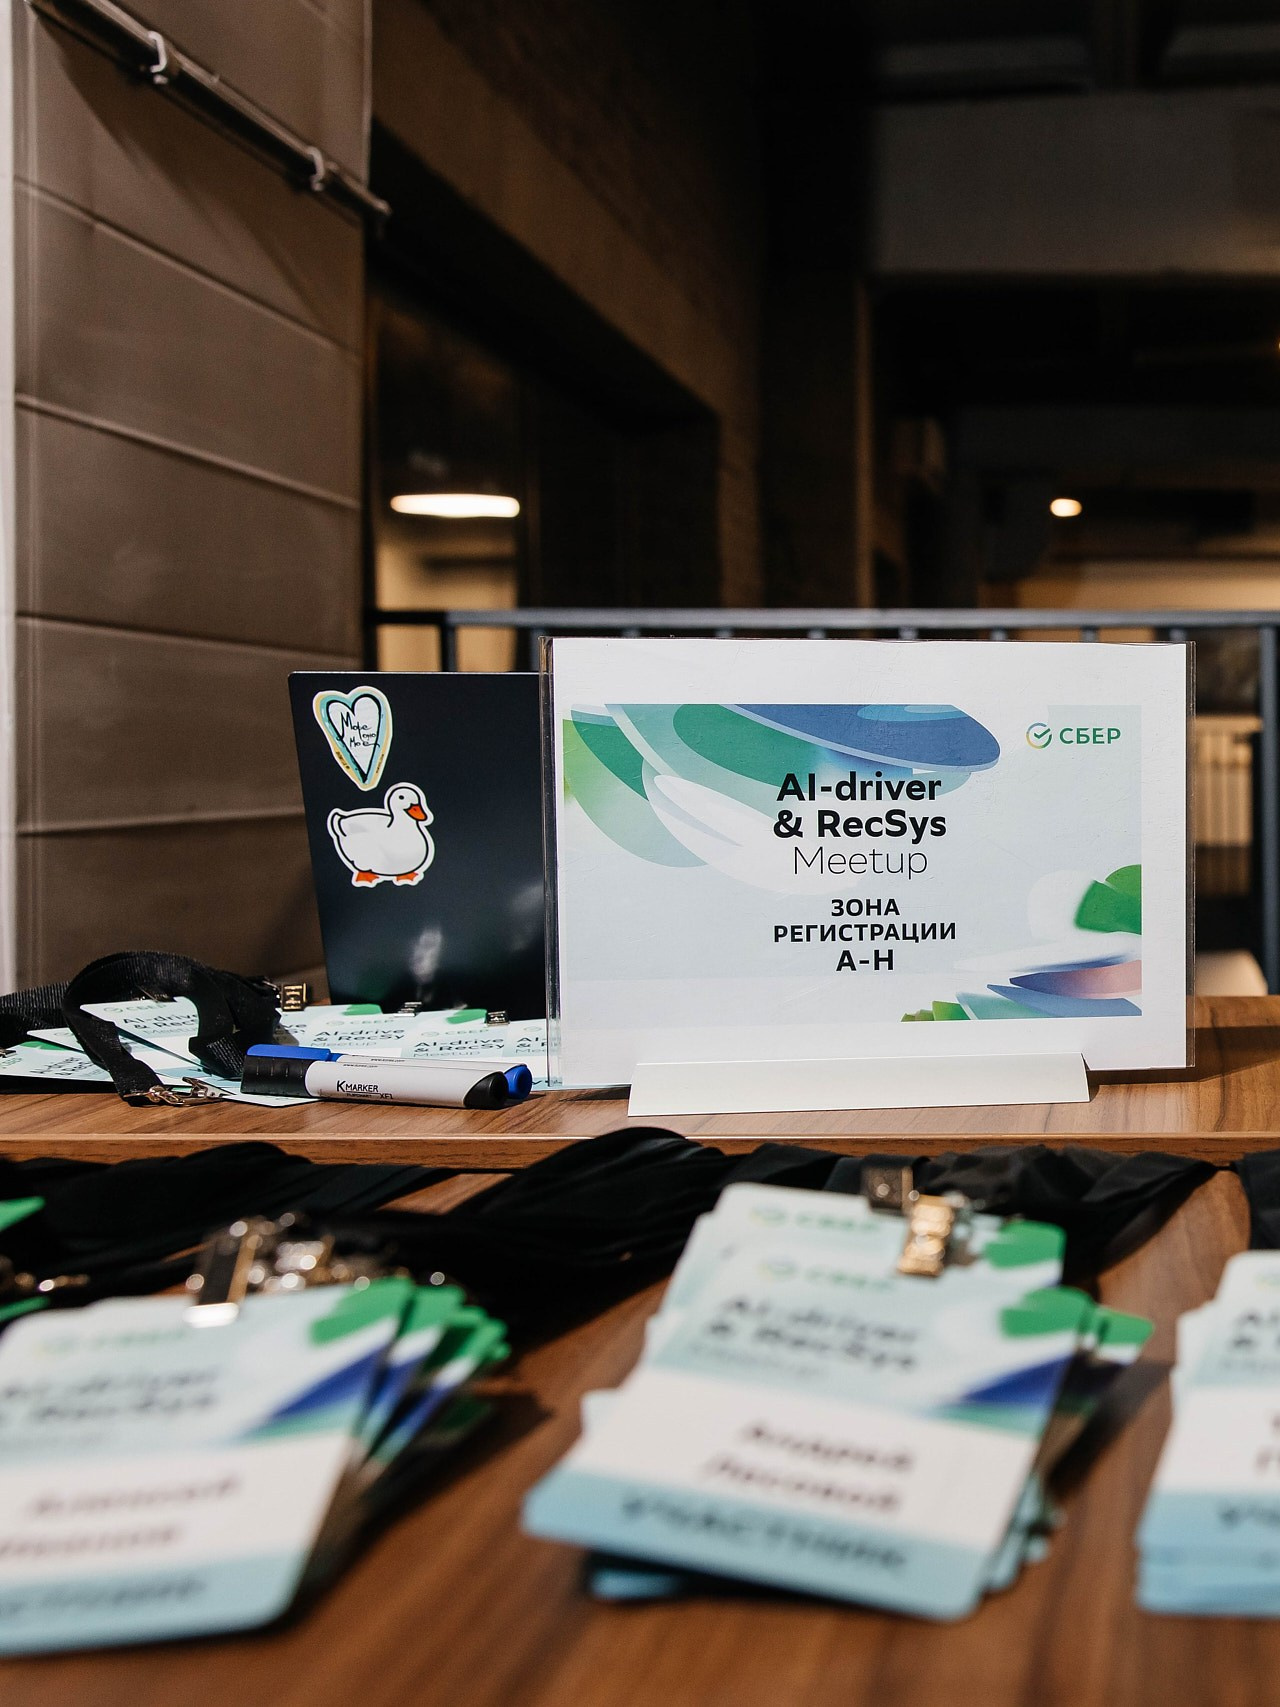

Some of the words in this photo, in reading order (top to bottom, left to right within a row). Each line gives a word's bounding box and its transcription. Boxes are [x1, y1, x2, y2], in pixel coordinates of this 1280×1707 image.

[1058, 727, 1122, 745] СБЕР
[776, 770, 942, 802] AI-driver
[773, 809, 804, 839] &
[817, 808, 948, 844] RecSys
[793, 846, 928, 881] Meetup
[830, 897, 901, 918] ЗОНА
[773, 922, 957, 944] РЕГИСТРАЦИИ
[835, 948, 895, 972] А-Н
[123, 1014, 197, 1024] AI-driv
[414, 1038, 504, 1047] AI-drive
